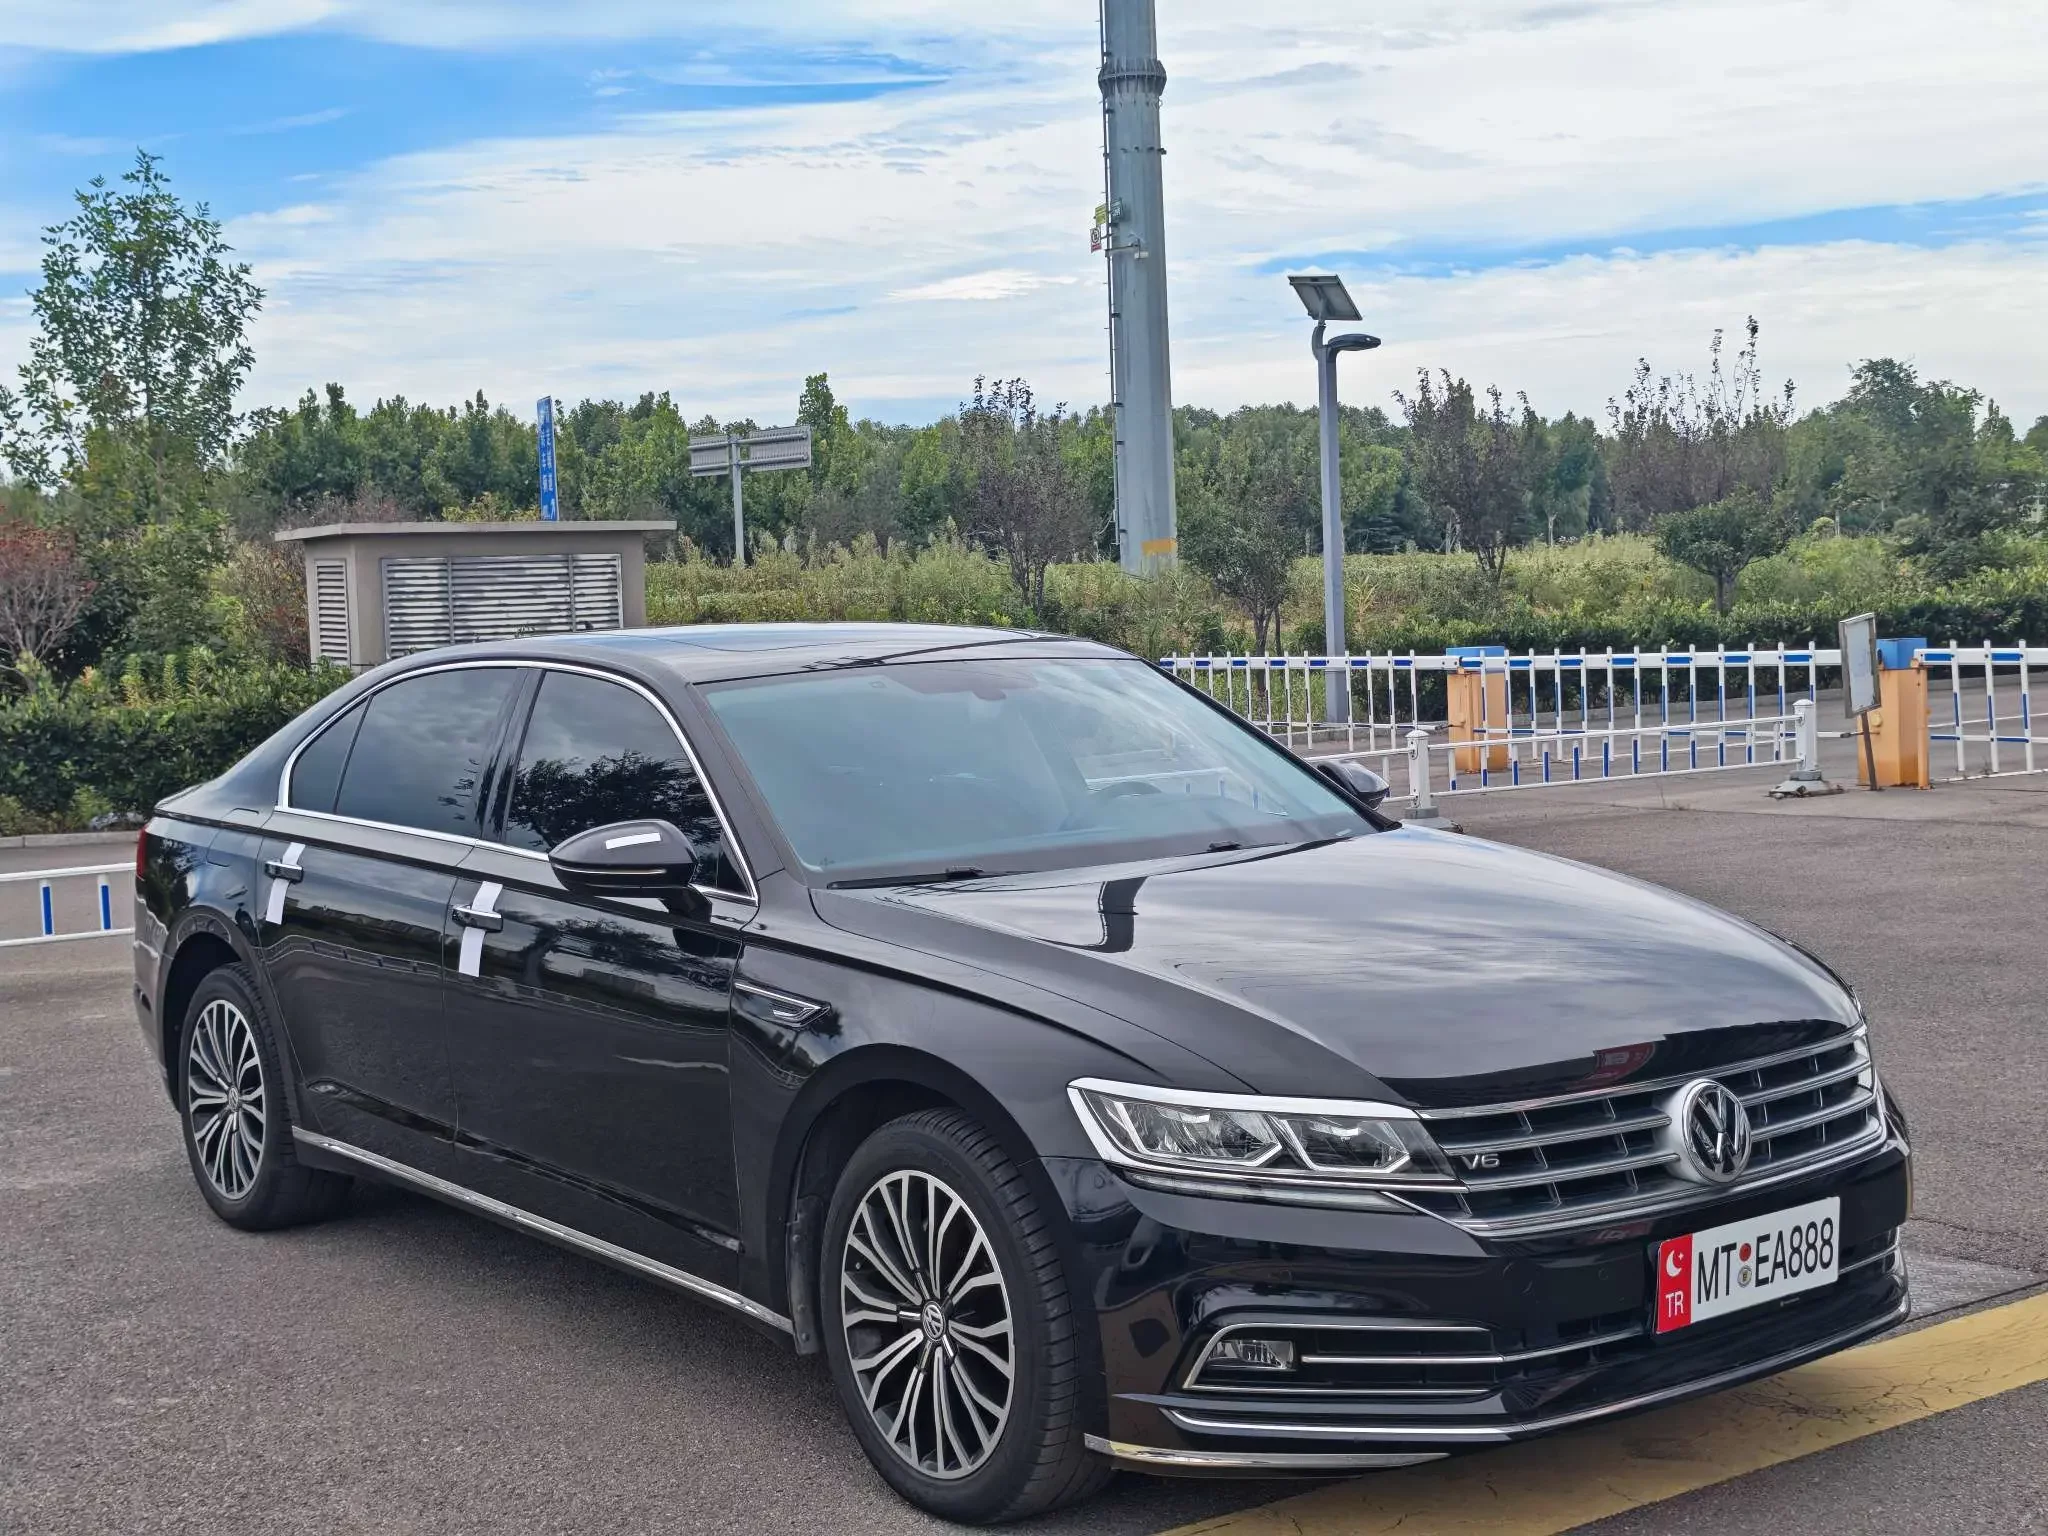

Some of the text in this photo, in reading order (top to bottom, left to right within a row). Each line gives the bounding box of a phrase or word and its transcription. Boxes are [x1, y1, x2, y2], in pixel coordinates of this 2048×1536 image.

[1461, 1153, 1500, 1170] V6
[1697, 1217, 1834, 1304] MT EA888
[1665, 1290, 1684, 1318] TR
